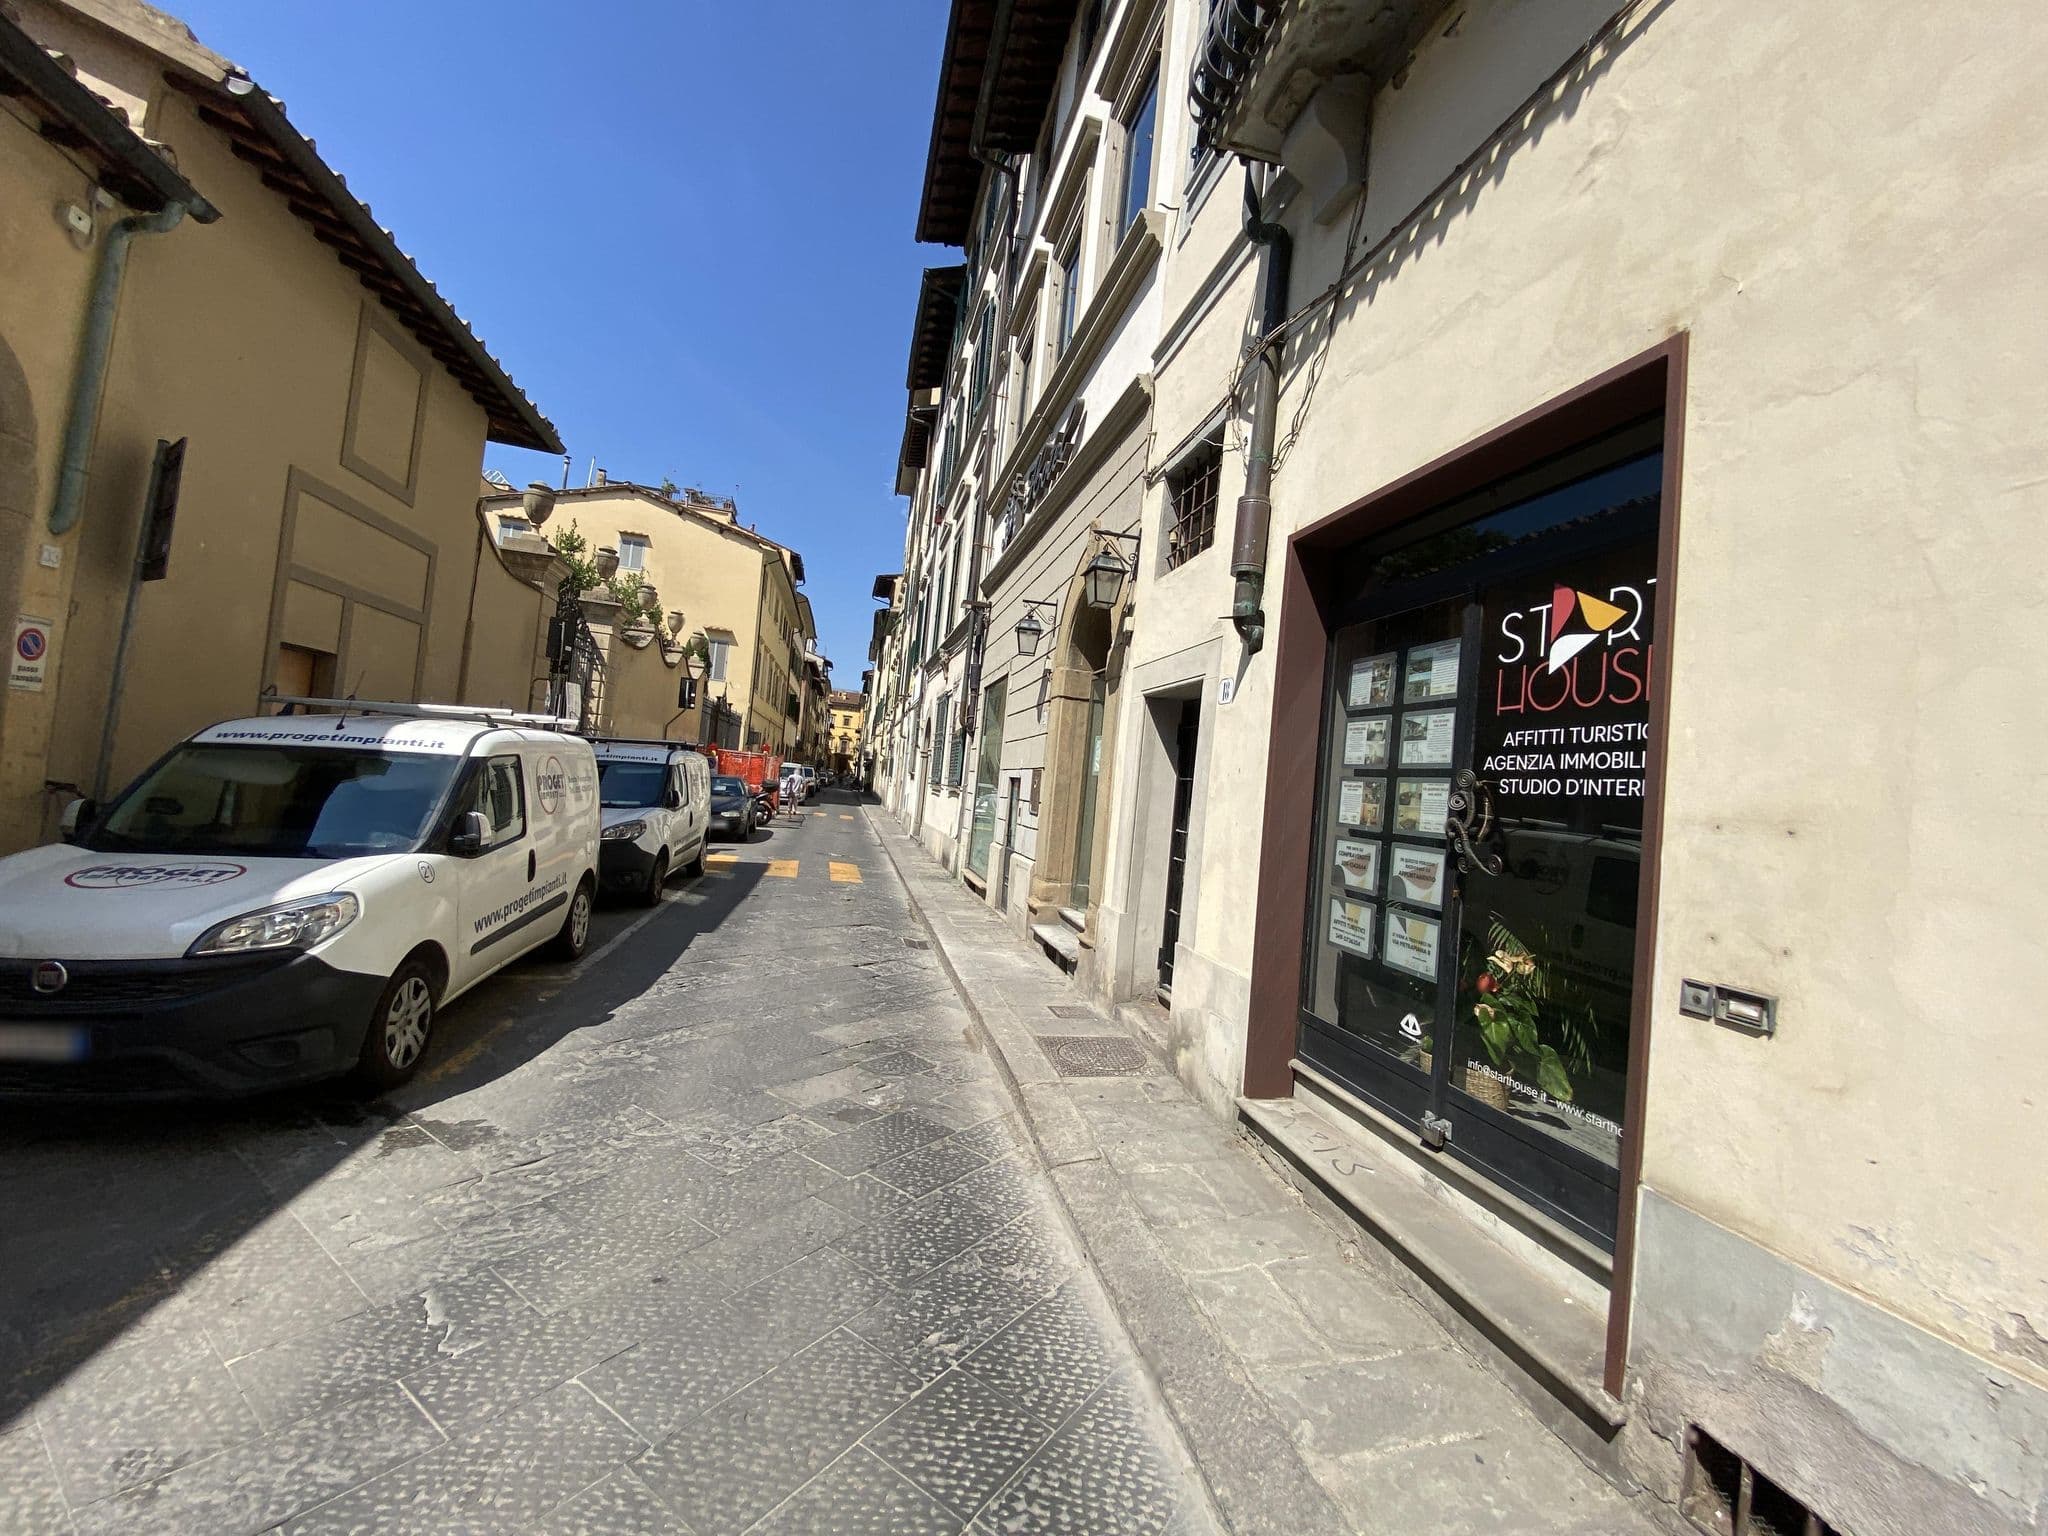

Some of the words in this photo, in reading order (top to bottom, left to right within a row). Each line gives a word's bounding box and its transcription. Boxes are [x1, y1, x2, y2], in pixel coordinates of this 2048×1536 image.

[1497, 644, 1653, 716] HOUS
[215, 730, 446, 750] www.progetimpianti.it
[1503, 728, 1565, 747] AFFITTI
[1483, 754, 1556, 771] AGENZIA
[536, 774, 565, 791] PROGET
[1499, 778, 1561, 795] STUDIO
[78, 866, 238, 879] PROGET
[474, 872, 568, 934] www.progetimpianti.it
[1467, 1057, 1547, 1103] info@starthouse.it
